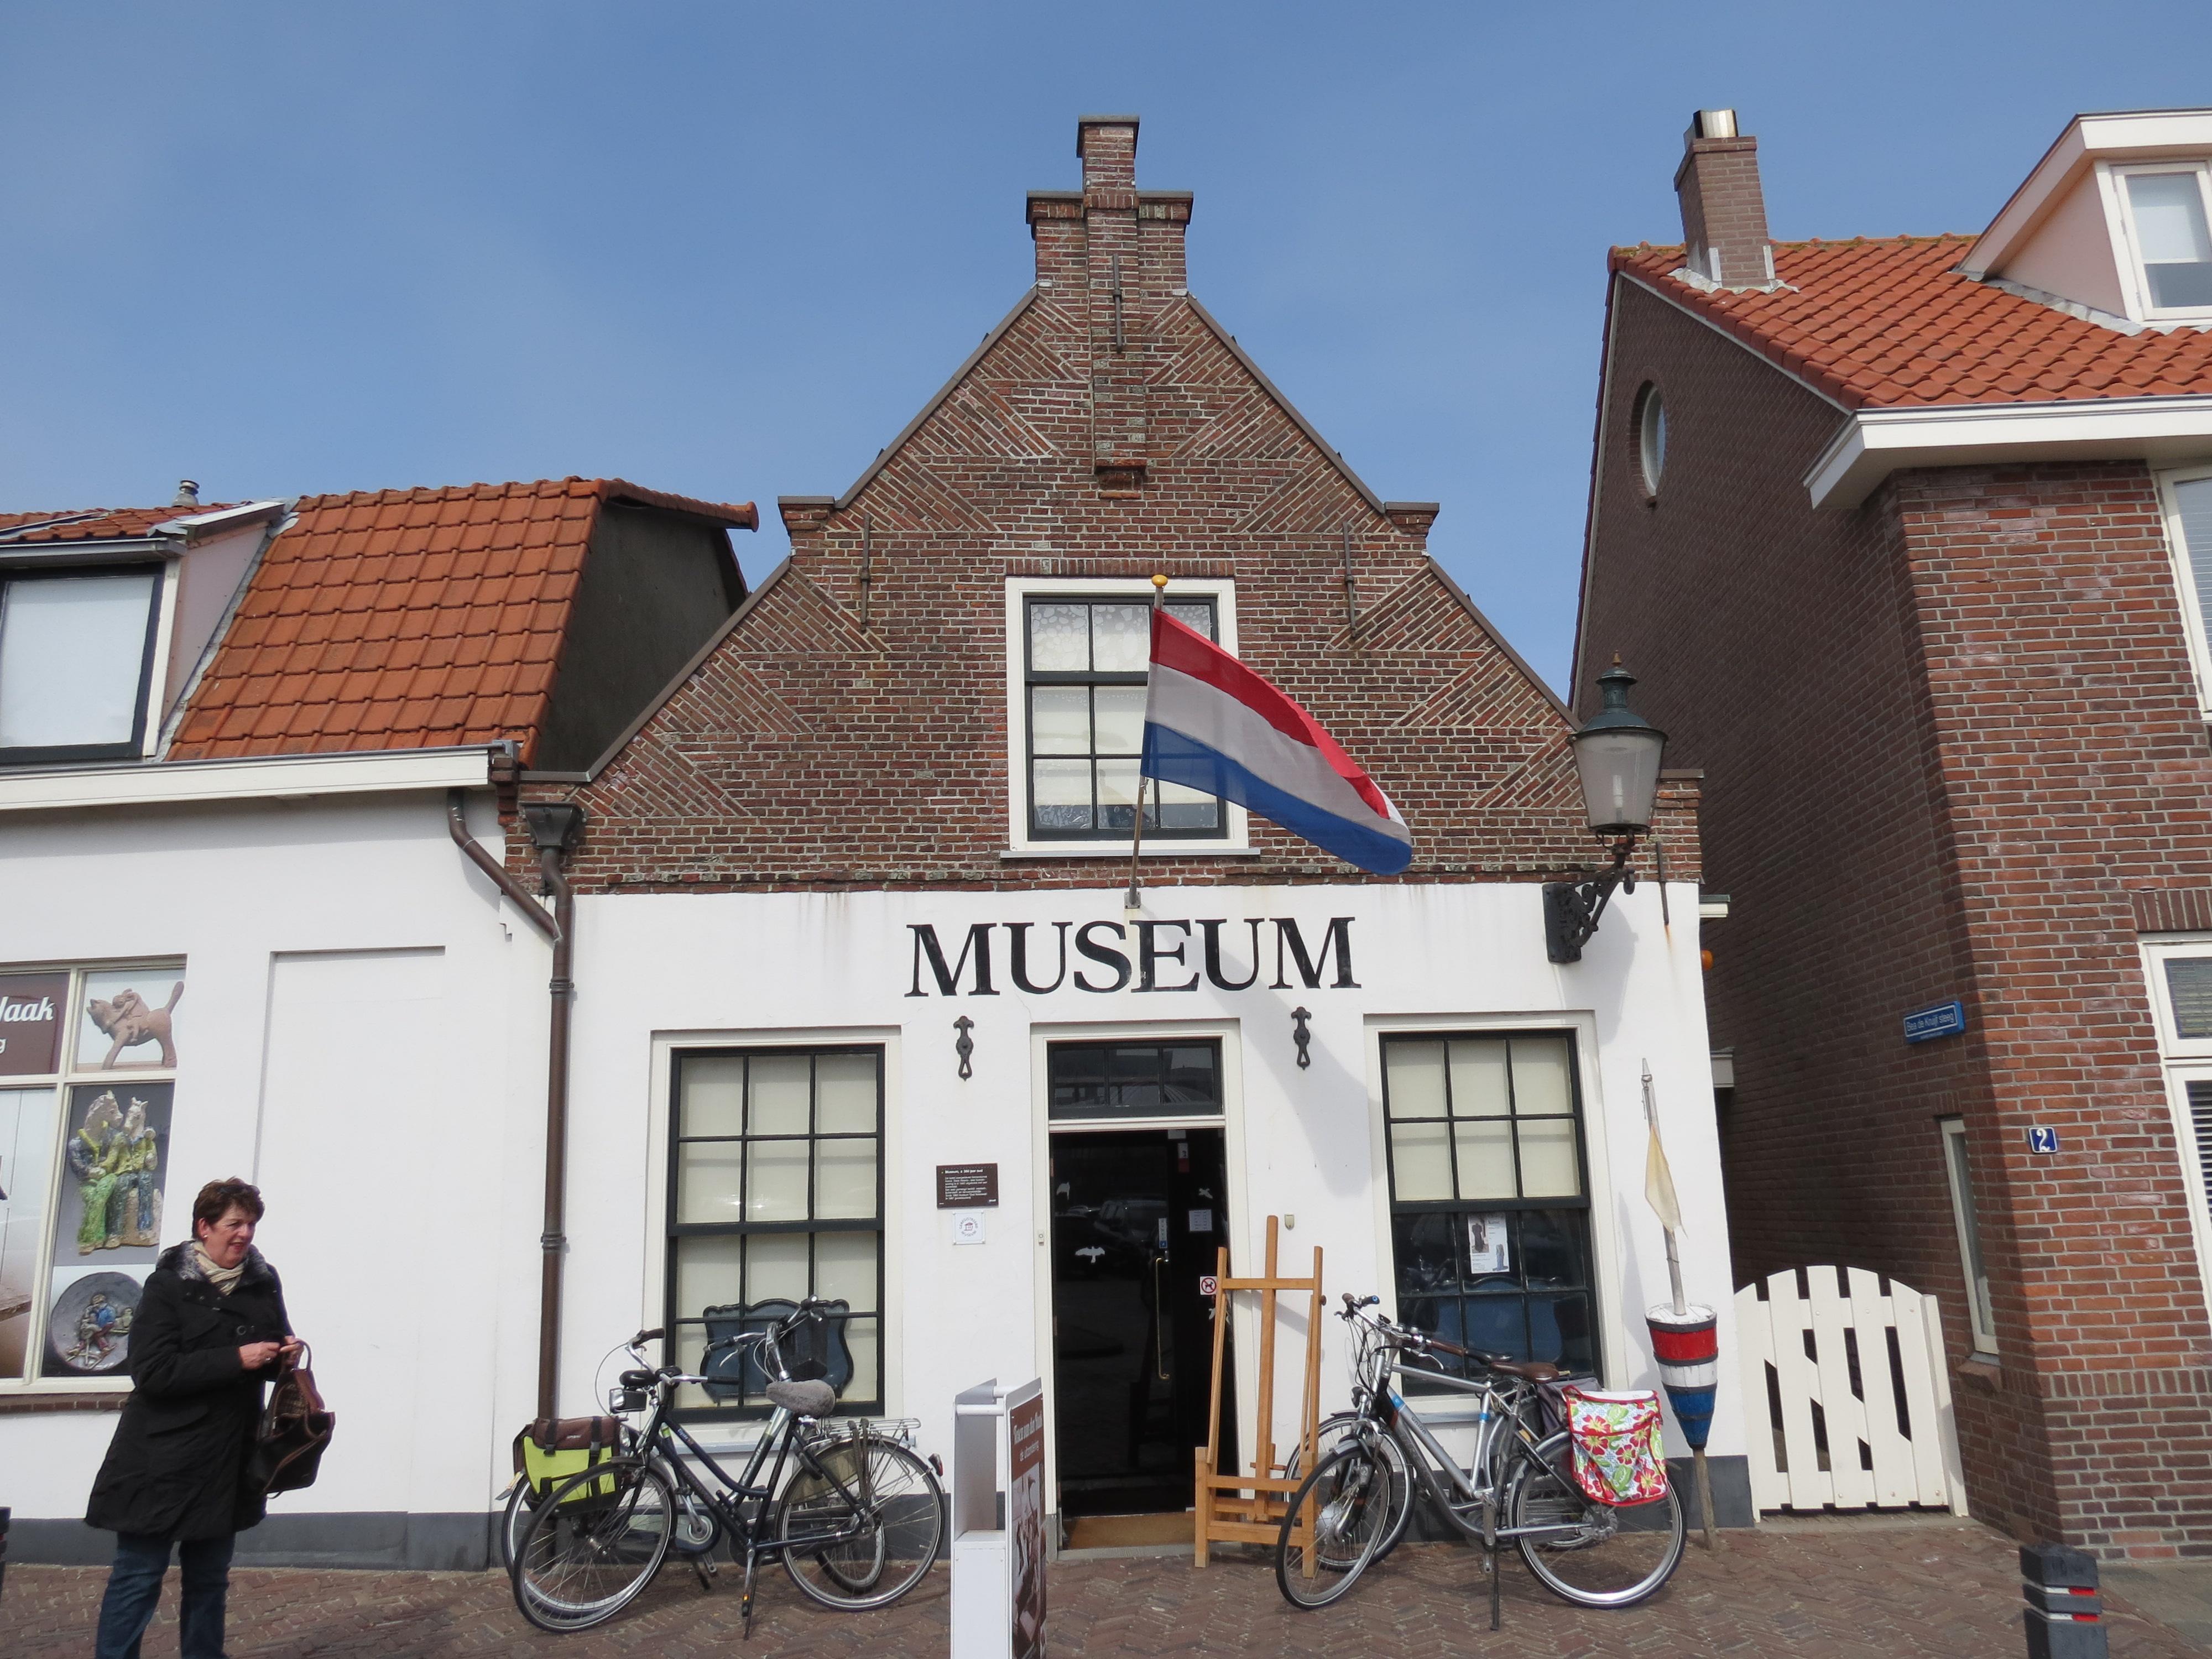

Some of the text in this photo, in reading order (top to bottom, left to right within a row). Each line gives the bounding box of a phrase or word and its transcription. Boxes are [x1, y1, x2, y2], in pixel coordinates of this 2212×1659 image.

[904, 916, 1362, 997] MUSEUM
[1917, 1019, 1924, 1029] de
[1938, 1013, 1954, 1024] steeg
[2036, 1128, 2051, 1151] 2
